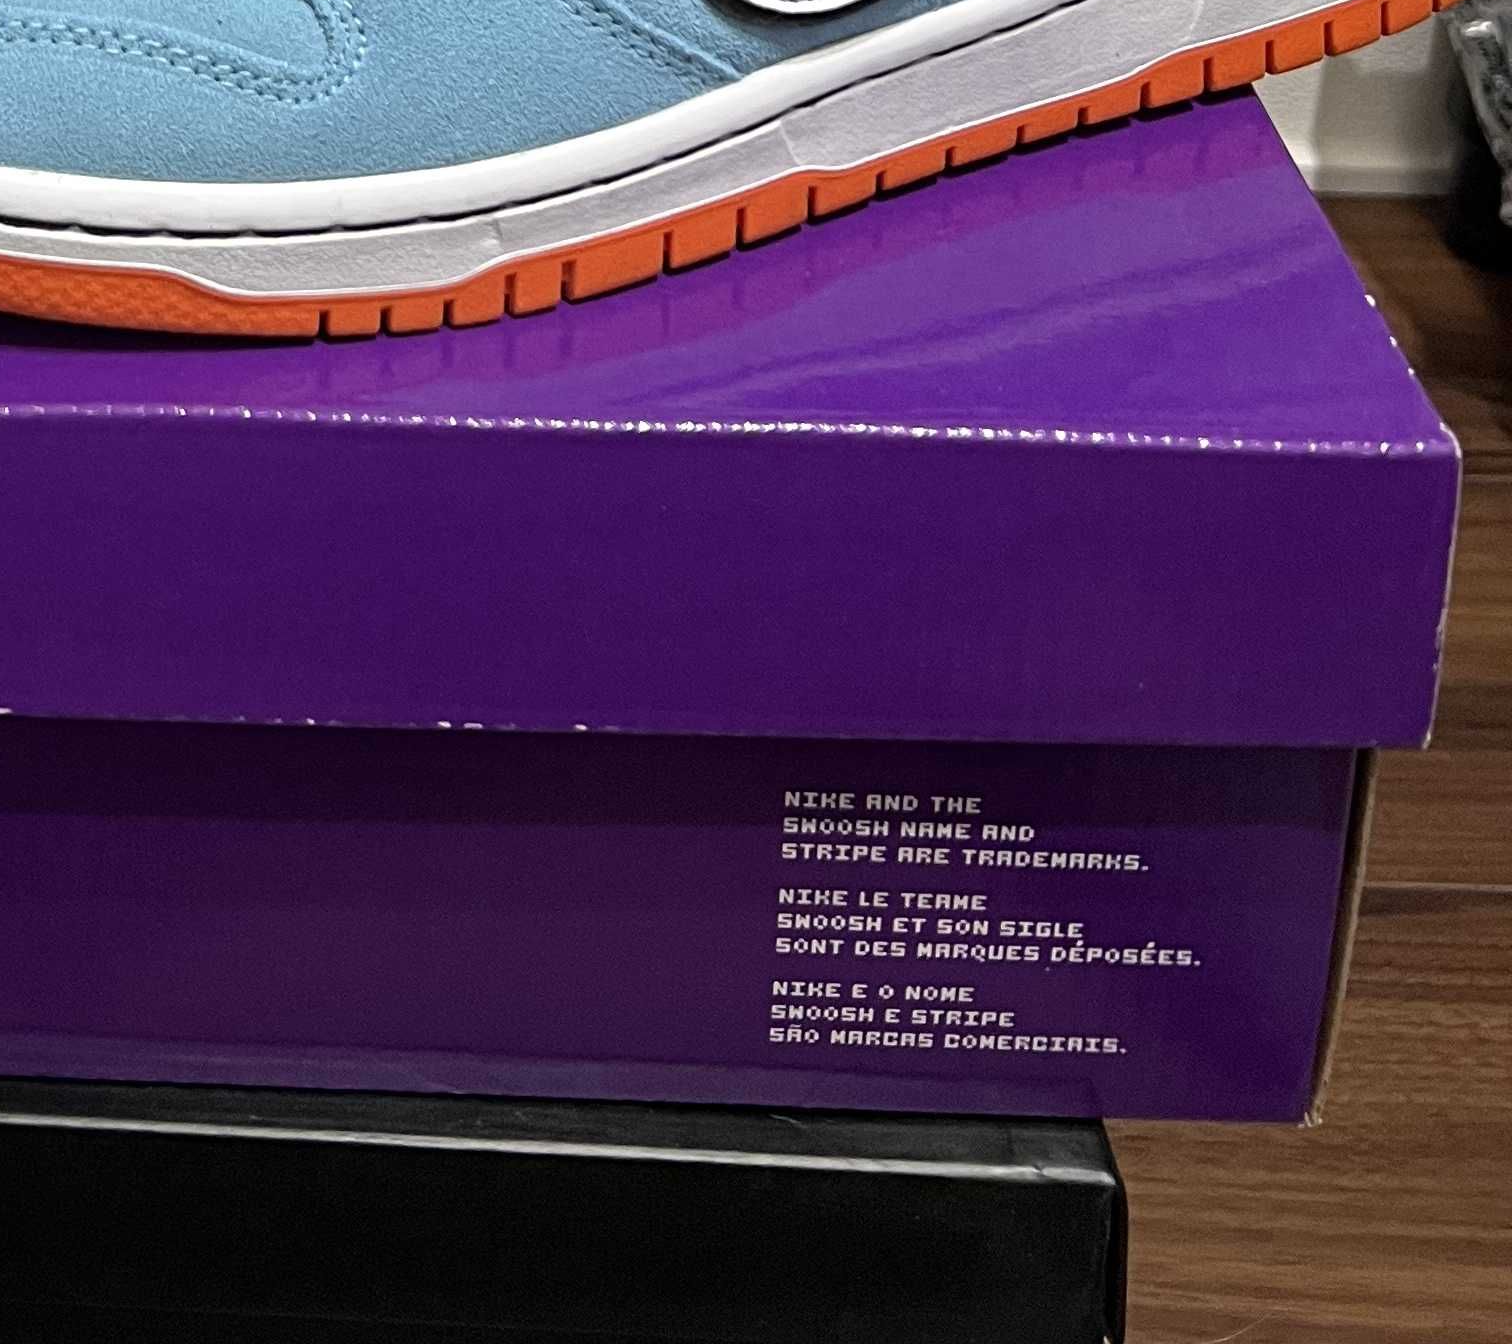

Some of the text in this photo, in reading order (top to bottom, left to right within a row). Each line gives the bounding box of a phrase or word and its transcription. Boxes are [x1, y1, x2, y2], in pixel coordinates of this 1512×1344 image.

[784, 791, 982, 814] NIKE AND THE
[783, 816, 1035, 843] SWOOSH NAME AND
[781, 842, 1149, 872] STRIPE ARE TRADEMARKS.
[778, 888, 849, 907] NIKE
[858, 890, 889, 908] LE
[777, 912, 1084, 939] SWOOSH ET SON SIGLE
[775, 937, 1201, 966] SONT DES MARQUES DÉPOSÉES.
[772, 980, 975, 1003] NIKE E O NOME
[770, 1004, 1015, 1028] SWOOSH E STRIPE
[768, 1023, 1127, 1055] SÃO MARCAS COMERCIAIS.
